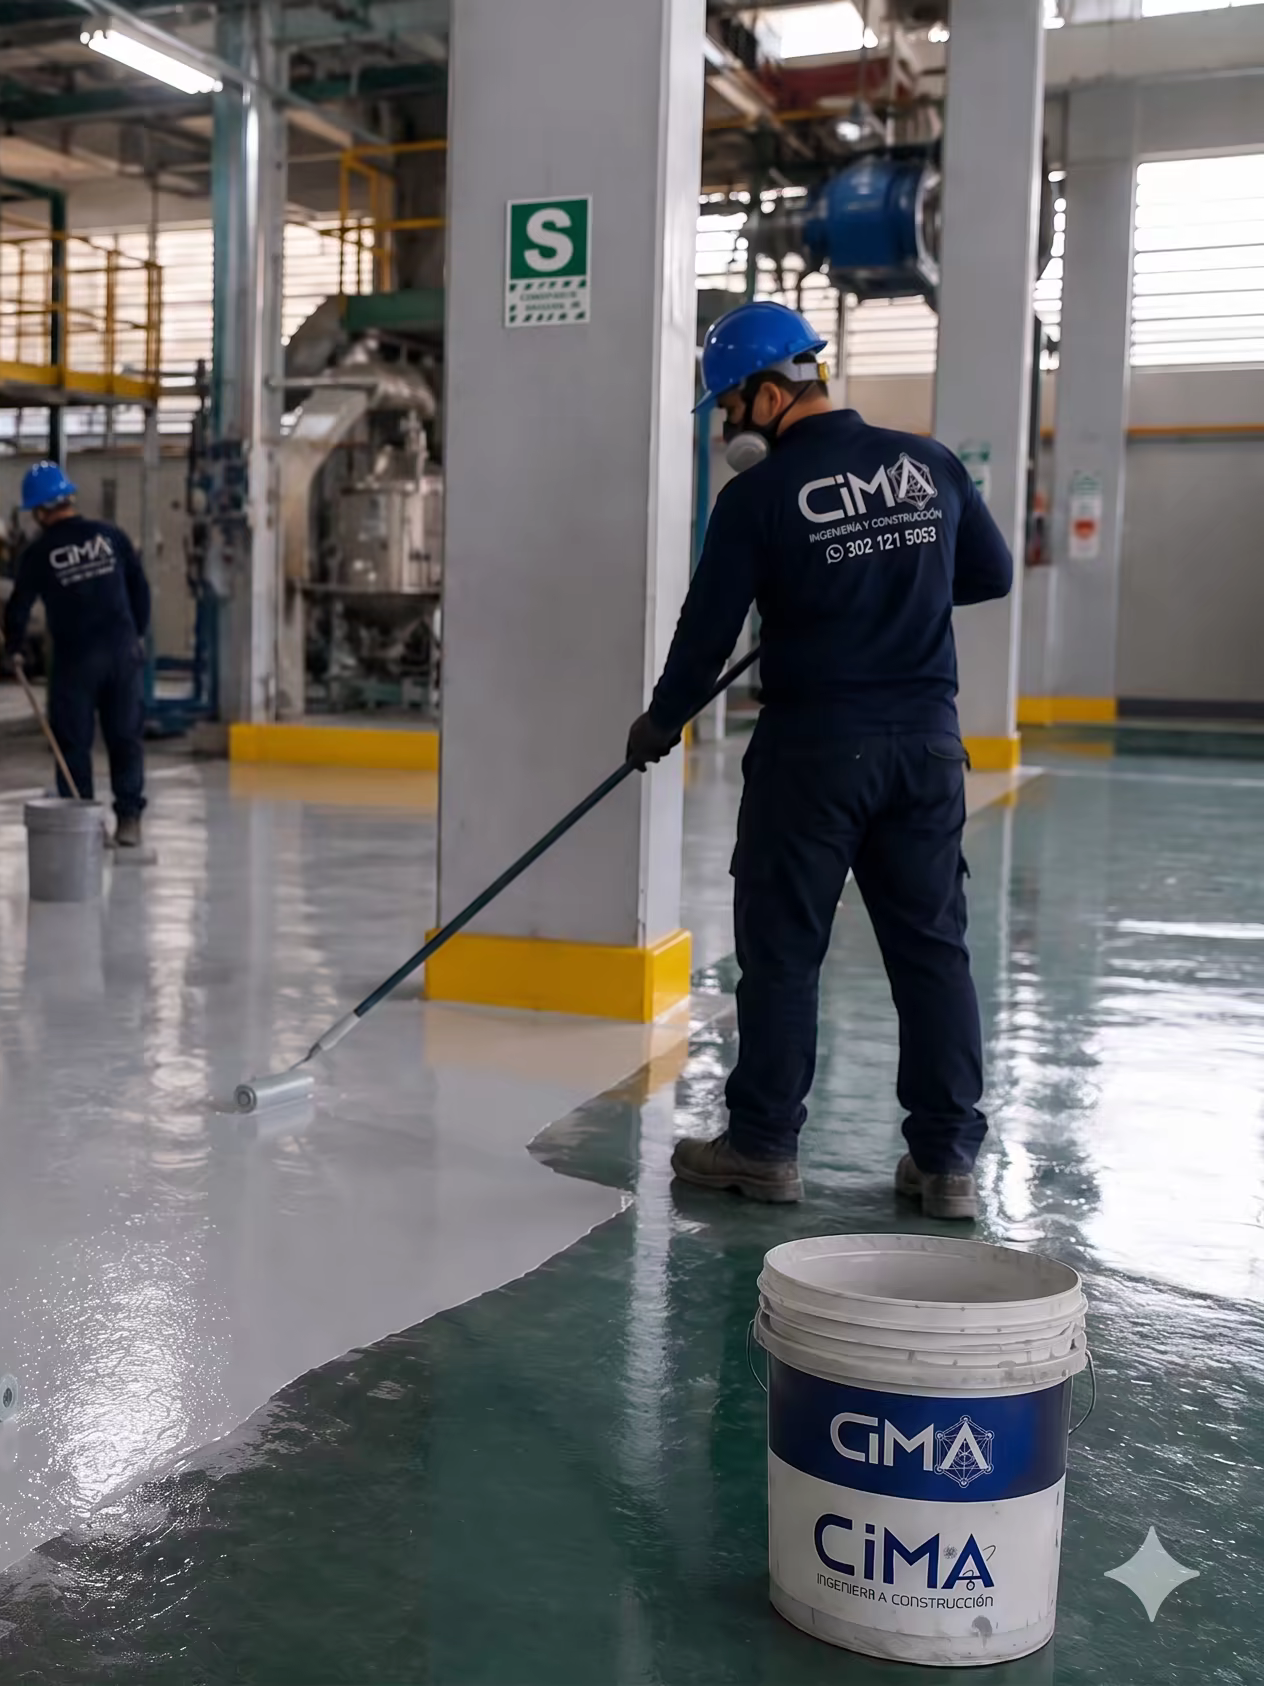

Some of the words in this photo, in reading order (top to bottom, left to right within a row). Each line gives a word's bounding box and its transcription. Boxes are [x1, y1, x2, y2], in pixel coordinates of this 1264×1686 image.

[523, 207, 574, 273] S
[863, 520, 870, 530] Y
[846, 538, 873, 558] 302
[877, 532, 901, 551] 121
[905, 526, 937, 545] 5053
[878, 1591, 887, 1603] A
